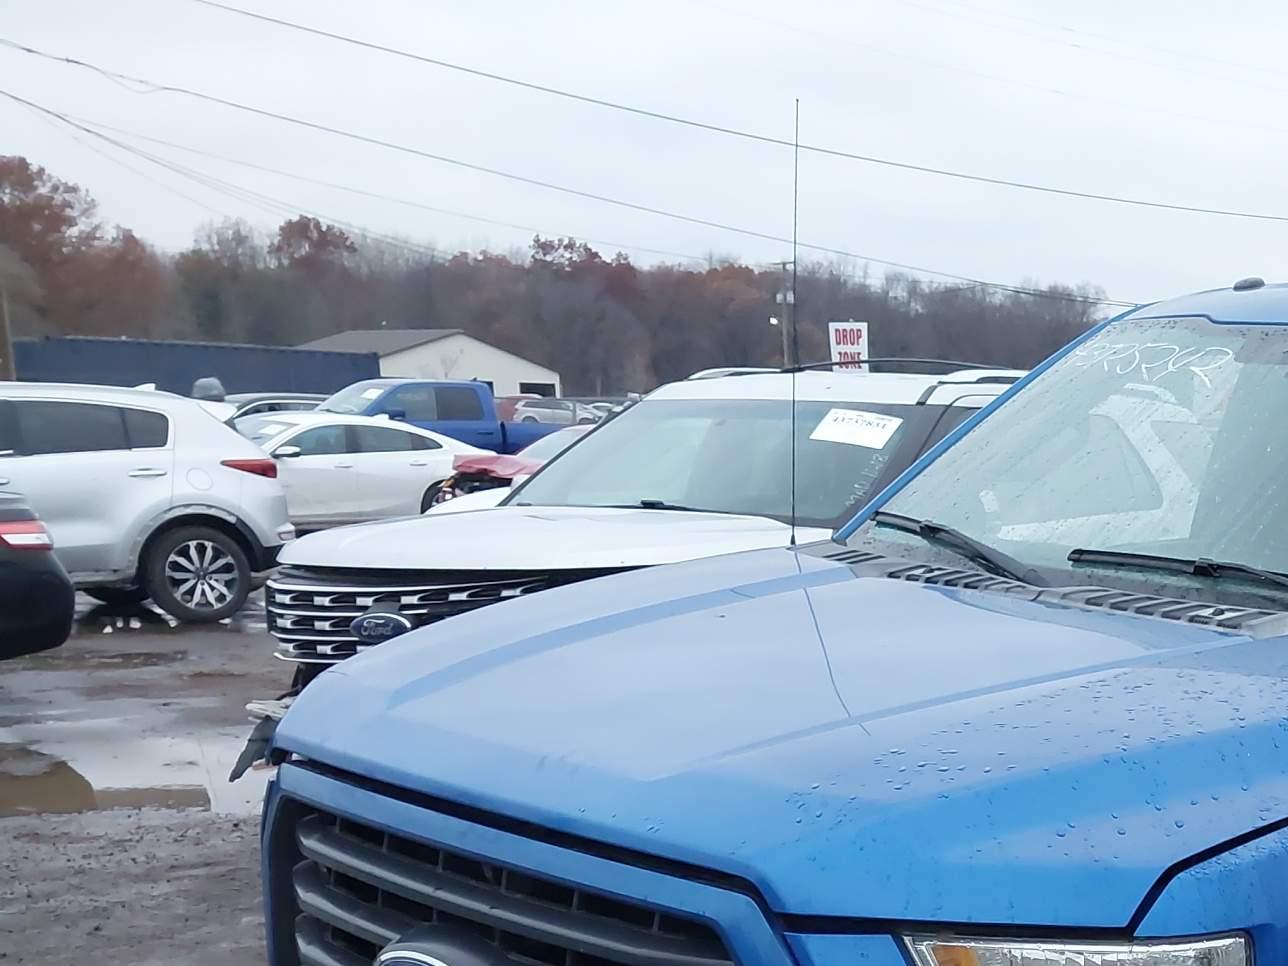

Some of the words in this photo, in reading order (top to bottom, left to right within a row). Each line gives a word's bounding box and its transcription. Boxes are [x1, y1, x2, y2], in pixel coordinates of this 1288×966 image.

[834, 327, 863, 346] DROP
[837, 351, 862, 369] ZONE
[361, 618, 394, 636] Ford
